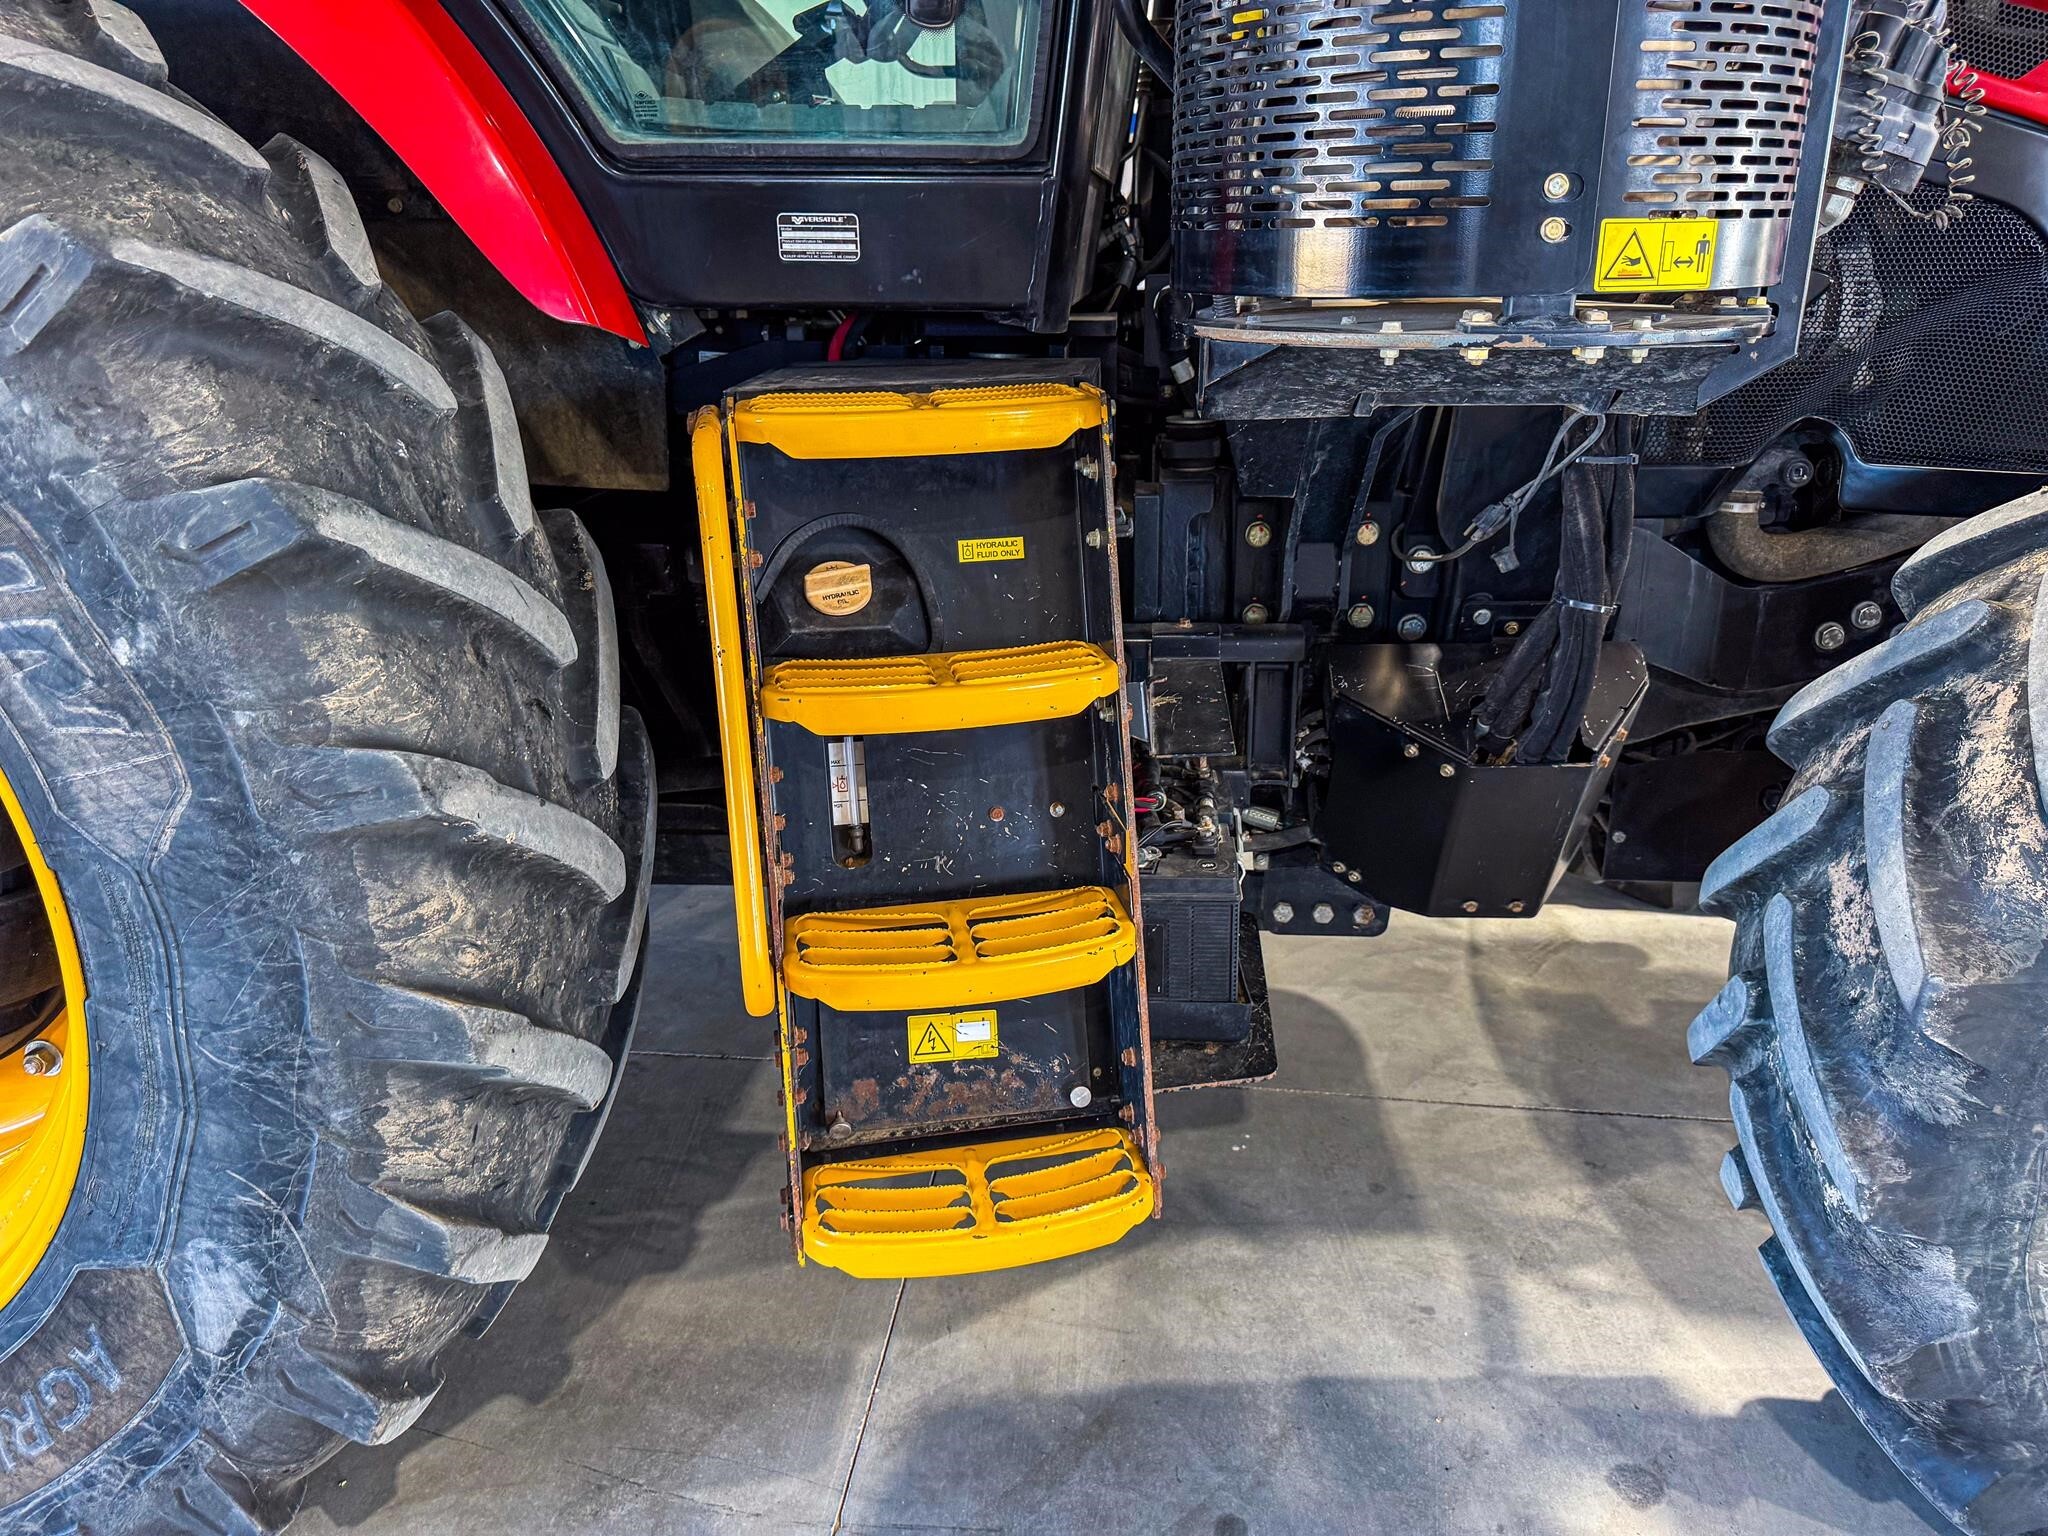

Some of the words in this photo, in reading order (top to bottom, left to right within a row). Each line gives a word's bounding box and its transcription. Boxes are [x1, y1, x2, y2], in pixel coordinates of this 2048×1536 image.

[976, 540, 1018, 549] HYDRAULIC
[976, 550, 998, 558] FLUID
[1000, 549, 1020, 557] ONLY
